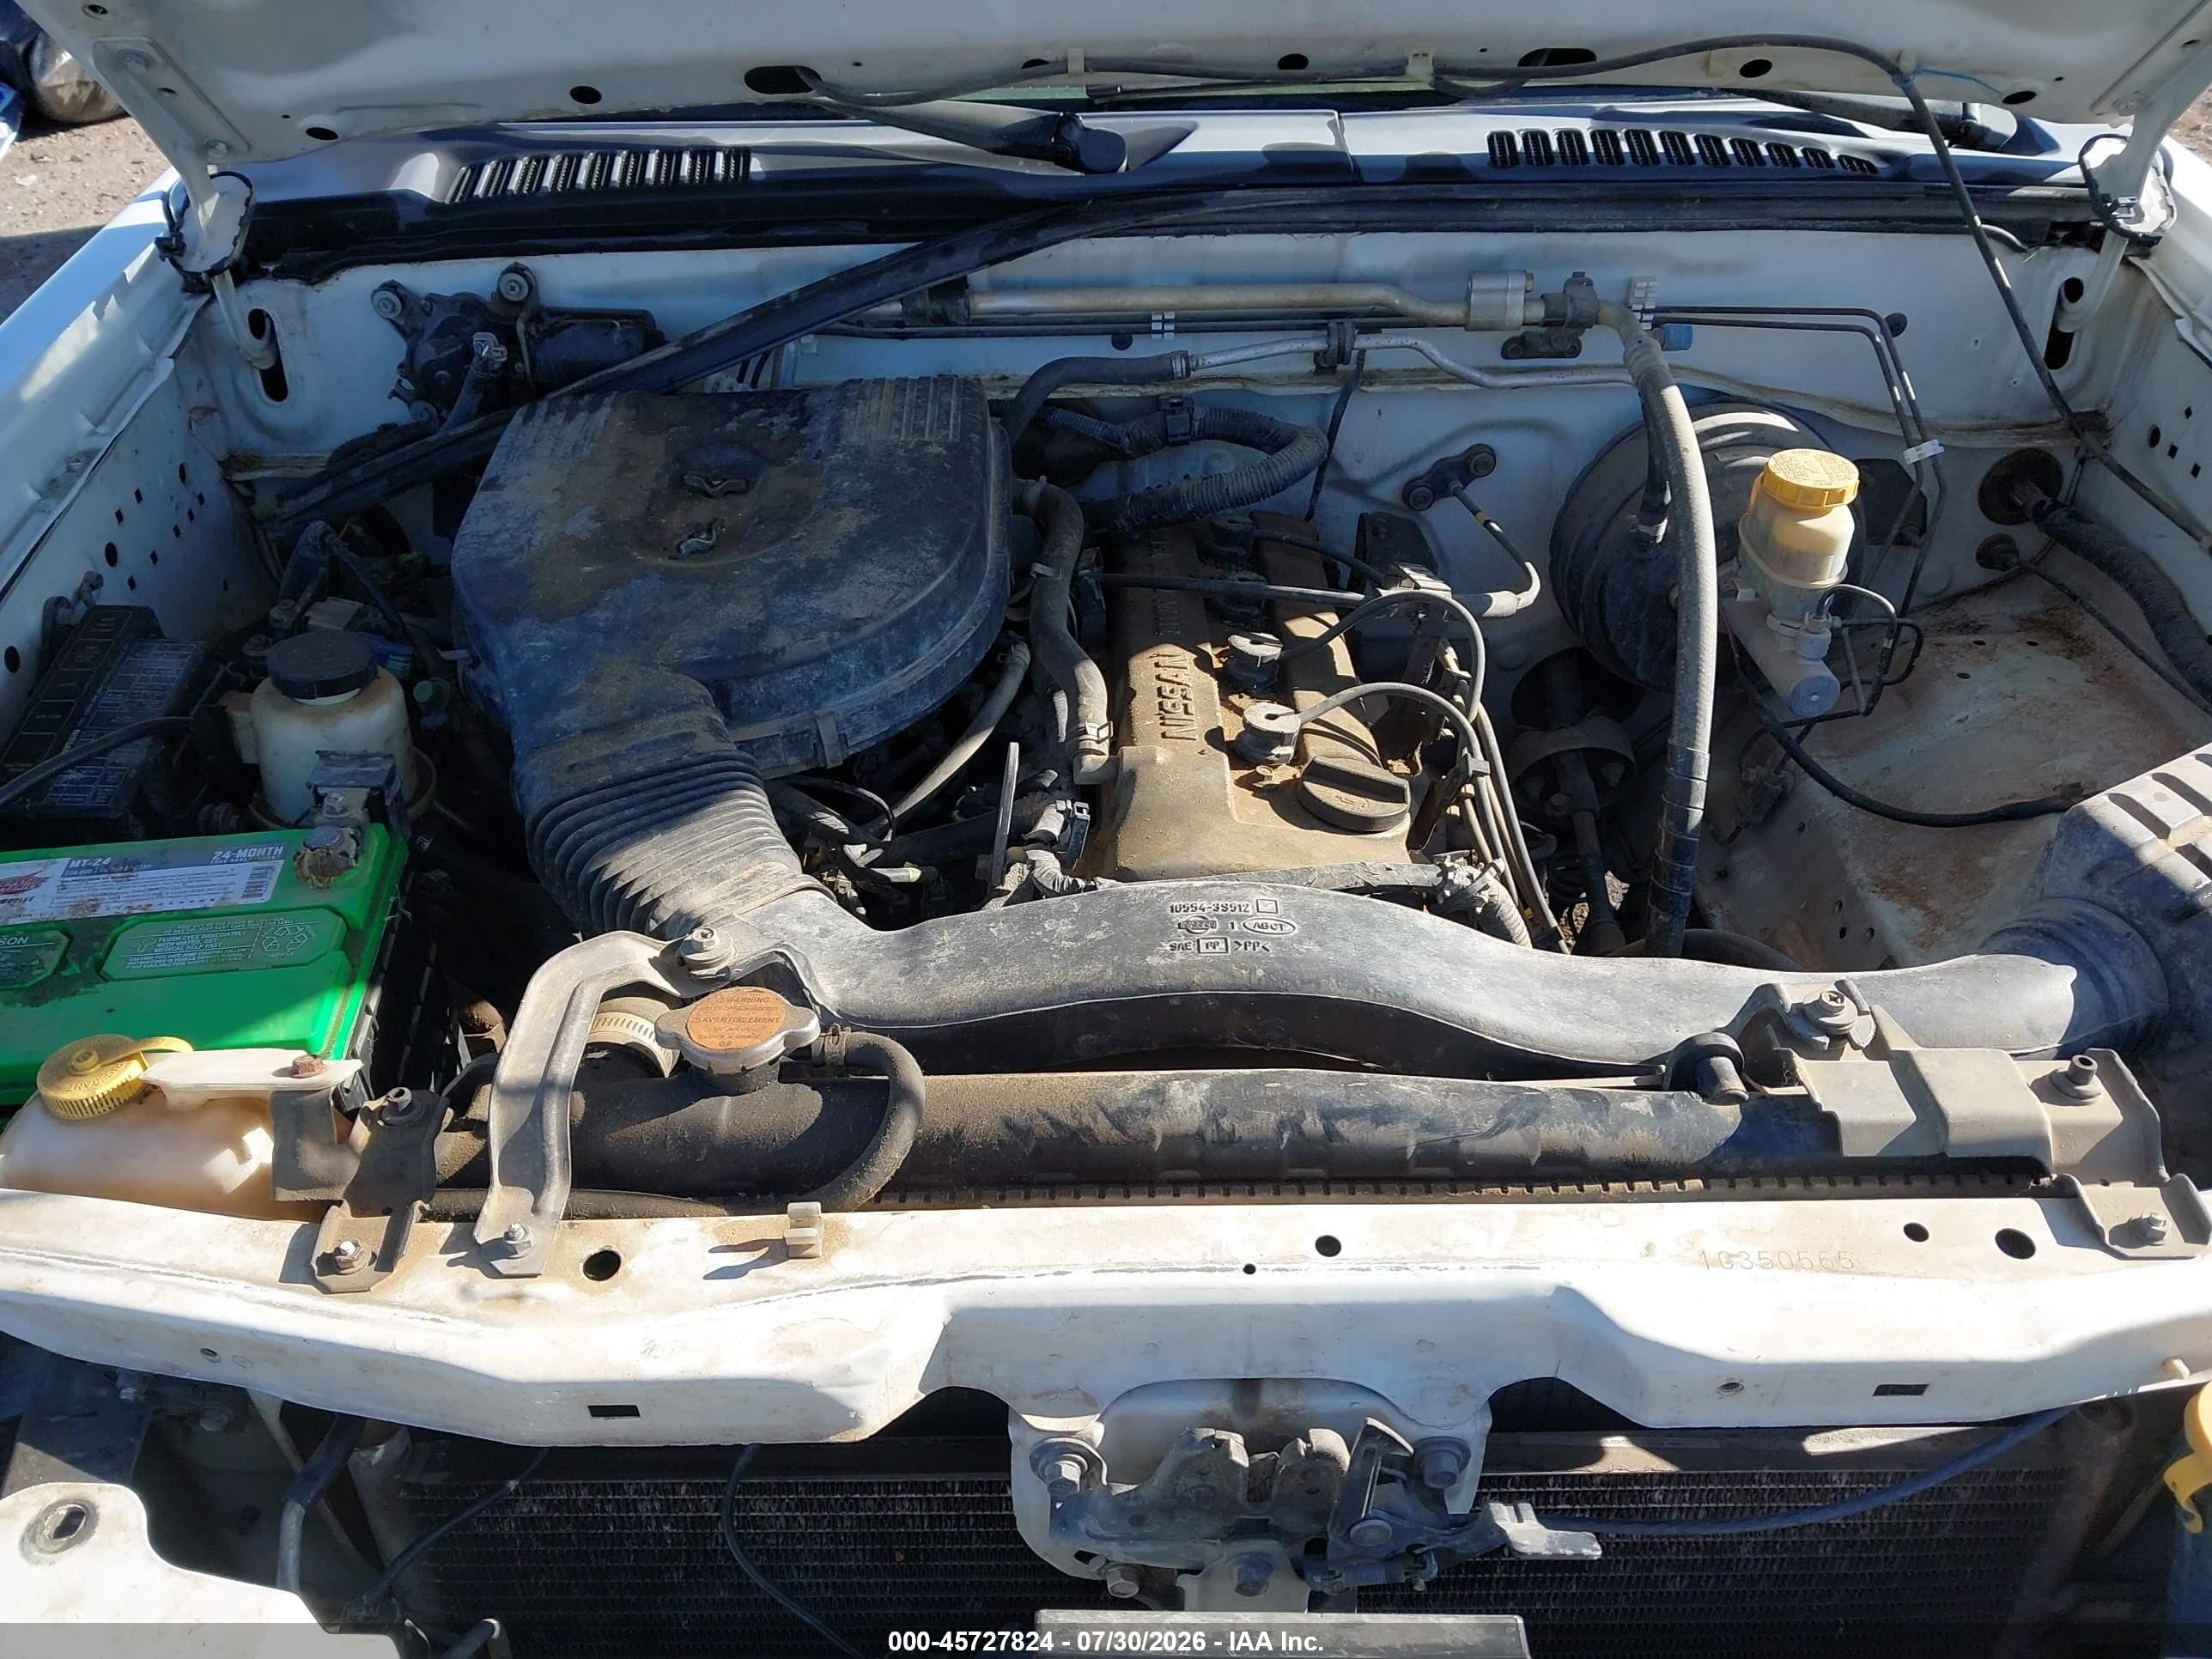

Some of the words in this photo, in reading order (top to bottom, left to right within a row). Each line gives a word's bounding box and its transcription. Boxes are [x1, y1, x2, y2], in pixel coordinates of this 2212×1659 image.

[1154, 652, 1197, 741] NISSAN
[212, 846, 284, 860] 24-MONTH
[1169, 943, 1192, 951] SAE
